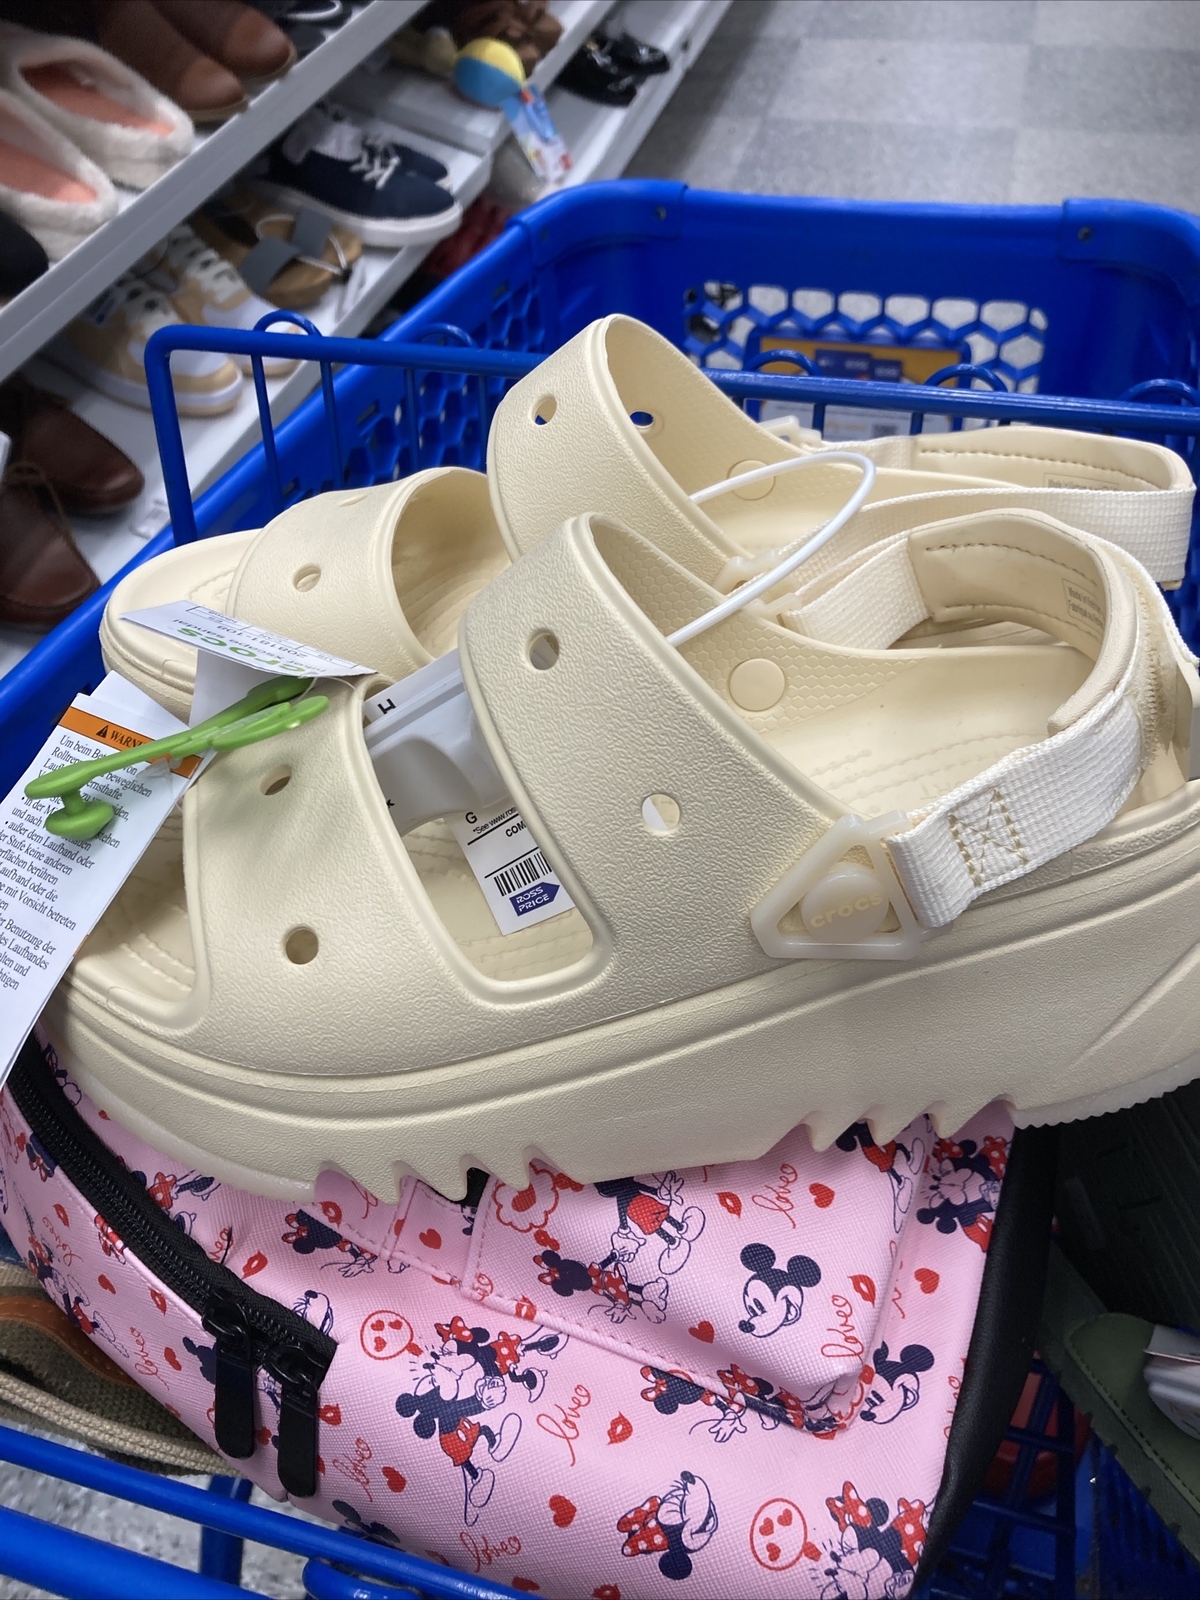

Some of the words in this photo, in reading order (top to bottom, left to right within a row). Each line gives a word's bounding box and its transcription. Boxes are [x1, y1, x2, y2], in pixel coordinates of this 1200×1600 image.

[173, 619, 225, 639] sandal
[177, 627, 306, 672] crocs
[59, 734, 74, 748] Um
[74, 740, 92, 756] beim
[86, 780, 123, 800] ernsthafte
[105, 772, 153, 798] beweglichen
[32, 799, 46, 811] der
[11, 807, 28, 819] und
[25, 814, 43, 827] nach
[465, 811, 478, 825] G
[7, 821, 29, 835] außer
[27, 829, 44, 844] dem
[42, 836, 80, 861] Laufband
[76, 856, 95, 870] oder
[7, 834, 26, 851] Stufe
[24, 843, 45, 861] keine
[43, 855, 73, 876] anderen
[27, 860, 59, 886] berühren
[28, 882, 47, 896] oder
[45, 888, 59, 903] die
[515, 886, 544, 904] ROSS
[518, 893, 550, 912] PRICE
[4, 886, 19, 899] mit
[18, 889, 48, 915] Vorsicht
[46, 905, 77, 931] betreten
[809, 893, 883, 929] crocs
[4, 918, 43, 951] Benutzung
[41, 940, 57, 956] der
[7, 938, 50, 971] Laufbandes
[13, 962, 31, 978] und
